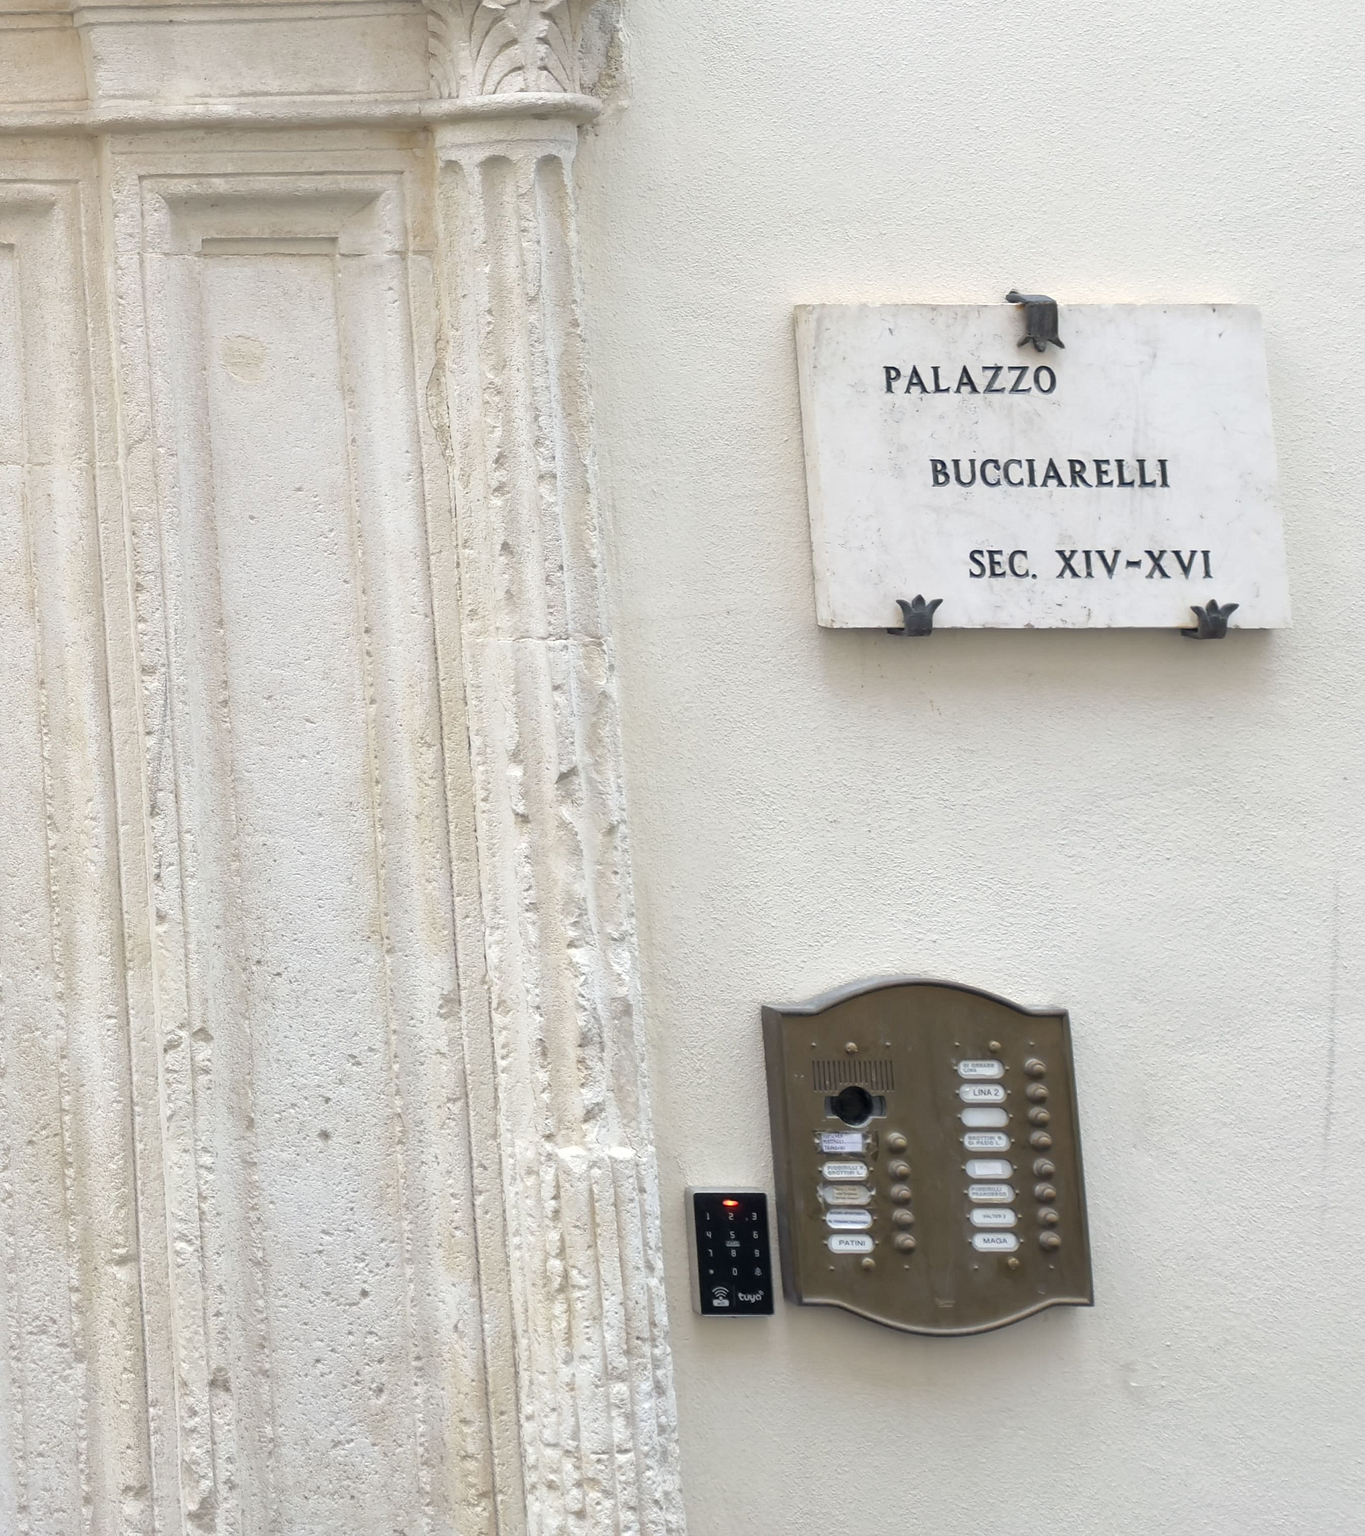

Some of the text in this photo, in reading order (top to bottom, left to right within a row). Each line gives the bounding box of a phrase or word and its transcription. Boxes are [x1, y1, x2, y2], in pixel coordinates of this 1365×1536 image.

[883, 365, 1057, 395] PALAZZO
[929, 458, 1171, 488] BUCCIARELLI
[969, 549, 1214, 580] SEC. XIV-XVI
[706, 1212, 757, 1220] 1 2 3
[706, 1231, 759, 1239] 4 5 6
[708, 1249, 760, 1257] 7 8 9
[732, 1267, 738, 1276] 0
[738, 1292, 762, 1303] tuya
